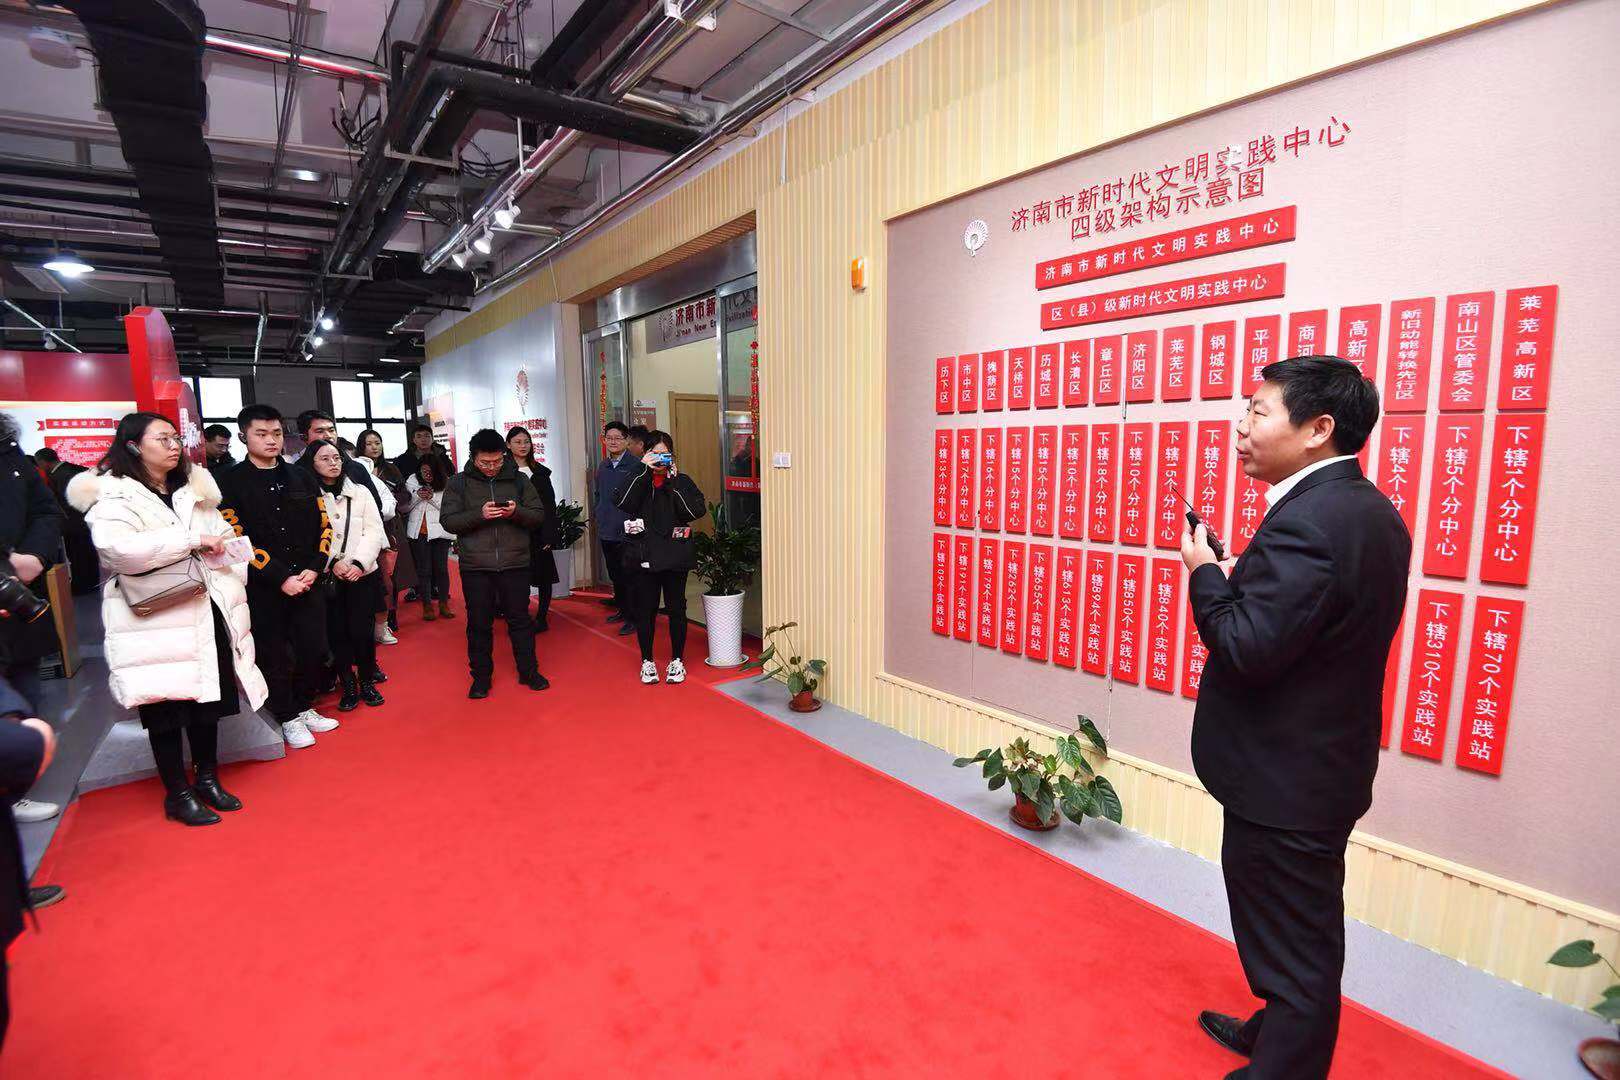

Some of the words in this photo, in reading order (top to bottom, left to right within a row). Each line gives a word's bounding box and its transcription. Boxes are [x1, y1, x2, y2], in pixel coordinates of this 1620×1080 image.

[1010, 115, 1351, 232] 济南市新时代文明实践中心
[1070, 168, 1266, 241] 四级架构示意图
[1044, 217, 1280, 281] 济南市新时代文明实践中心
[940, 365, 949, 403] 历下区
[961, 363, 972, 402] 市中区
[986, 360, 998, 401] 槐荫区
[1013, 356, 1024, 399] 天桥区
[1039, 353, 1052, 397] 历城区
[1069, 351, 1082, 395] 长清区
[1099, 347, 1113, 393] 章丘区
[1131, 343, 1148, 390] 济阳区
[1168, 338, 1185, 387] 莱芜区
[1208, 334, 1227, 385] 钢城区
[1395, 308, 1422, 401] 新旧动能转换先行区
[1450, 300, 1481, 404] 南山区管委会
[1511, 294, 1543, 402] 莱芜高新区
[938, 434, 948, 520] 下辖13个分中心
[959, 434, 971, 522] 下辖17个分中心
[984, 433, 996, 525] 下辖16个分中心
[1035, 432, 1050, 529] 下辖15个分中心
[1064, 431, 1080, 532] 下辖10个分中心
[1093, 430, 1111, 535] 下辖18个分中心
[1126, 430, 1145, 538] 下辖10个分中心
[1161, 429, 1182, 542] 下辖15个分中心
[1435, 425, 1471, 557] 下辖5个分中心
[1494, 426, 1532, 562] 下辖1个分中心
[1087, 558, 1105, 666] 下辖894个实践站
[1118, 562, 1137, 674] 下辖850个实践站
[1152, 567, 1174, 682] 下辖840个实践站
[1412, 601, 1451, 747] 下辖310个实践站
[1468, 608, 1511, 762] 下辖70个实践站
